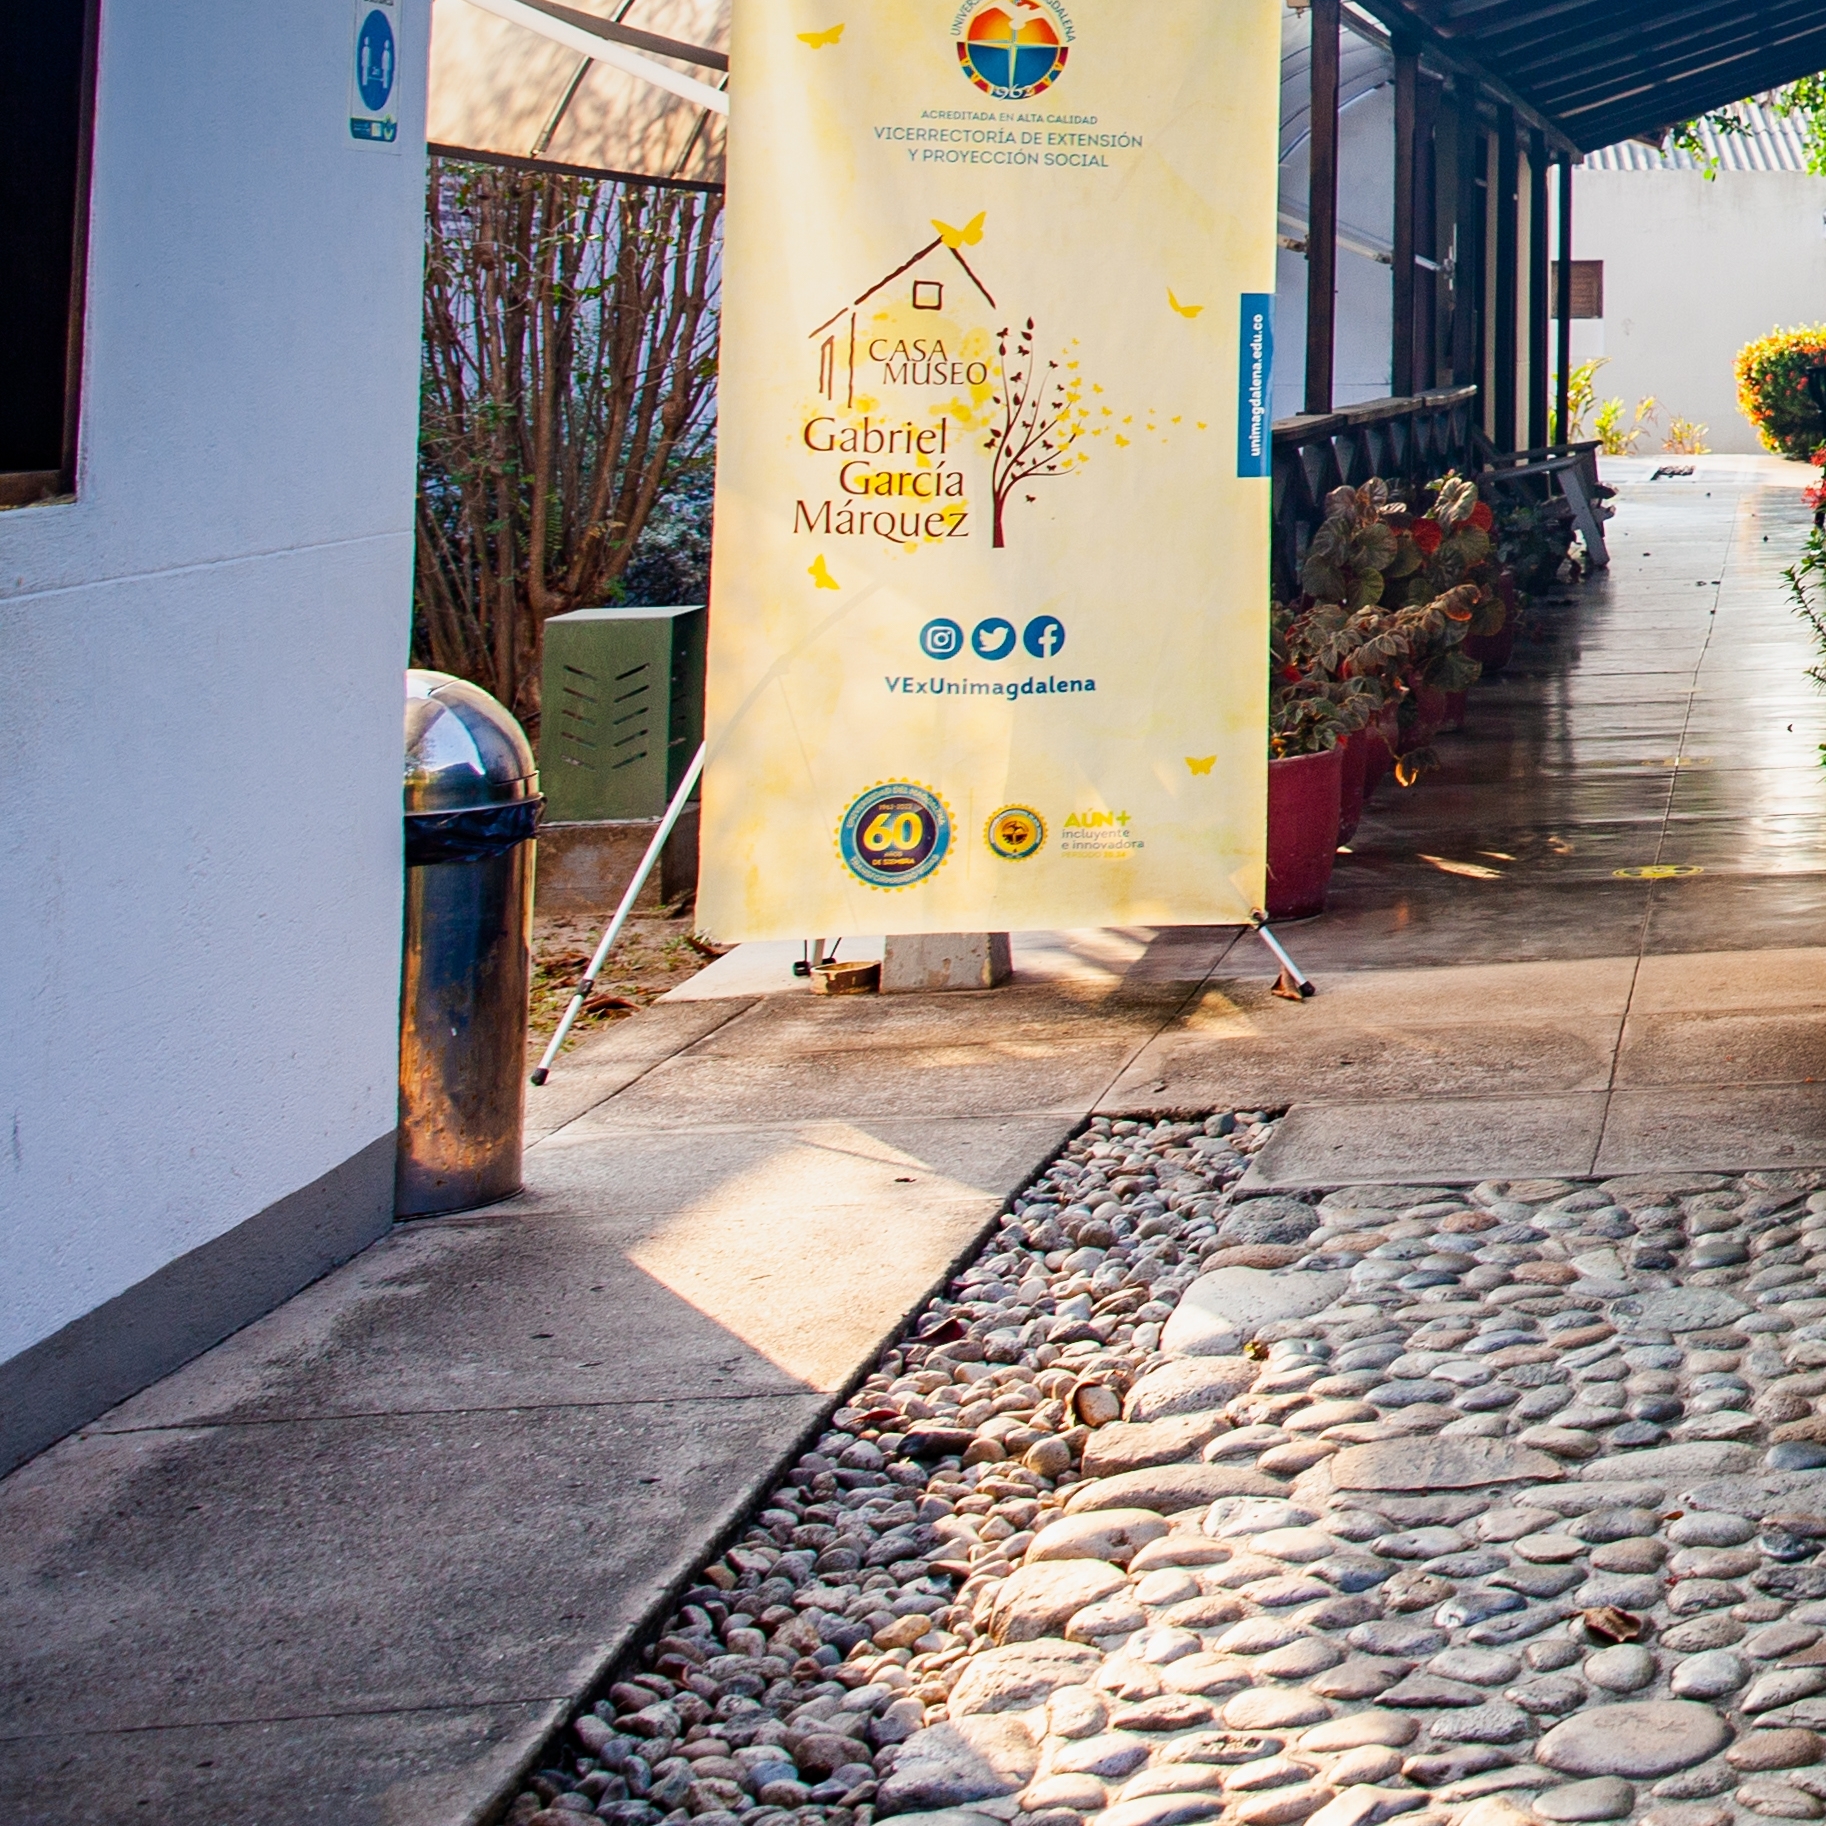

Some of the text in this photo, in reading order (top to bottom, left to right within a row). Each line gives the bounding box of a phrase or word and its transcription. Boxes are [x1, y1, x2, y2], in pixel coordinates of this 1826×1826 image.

[921, 110, 1098, 125] ACREDITADA EN ALTA CALIDAD
[873, 126, 1143, 148] VICERRECTORÍA DE EXTENSIÓN
[907, 148, 1109, 168] Y PROYECCIÓN SOCIAL
[869, 338, 948, 362] CASA
[883, 361, 988, 385] MUSEO
[1248, 313, 1265, 457] unimagdalena.edu.co
[803, 417, 947, 454] Gabriel
[839, 460, 964, 497] García
[793, 499, 969, 544] Márquez
[885, 676, 1096, 701] VExUnimagdalena
[863, 812, 923, 851] 60
[1062, 829, 1130, 840] incluyente
[1061, 839, 1144, 850] e innovadora
